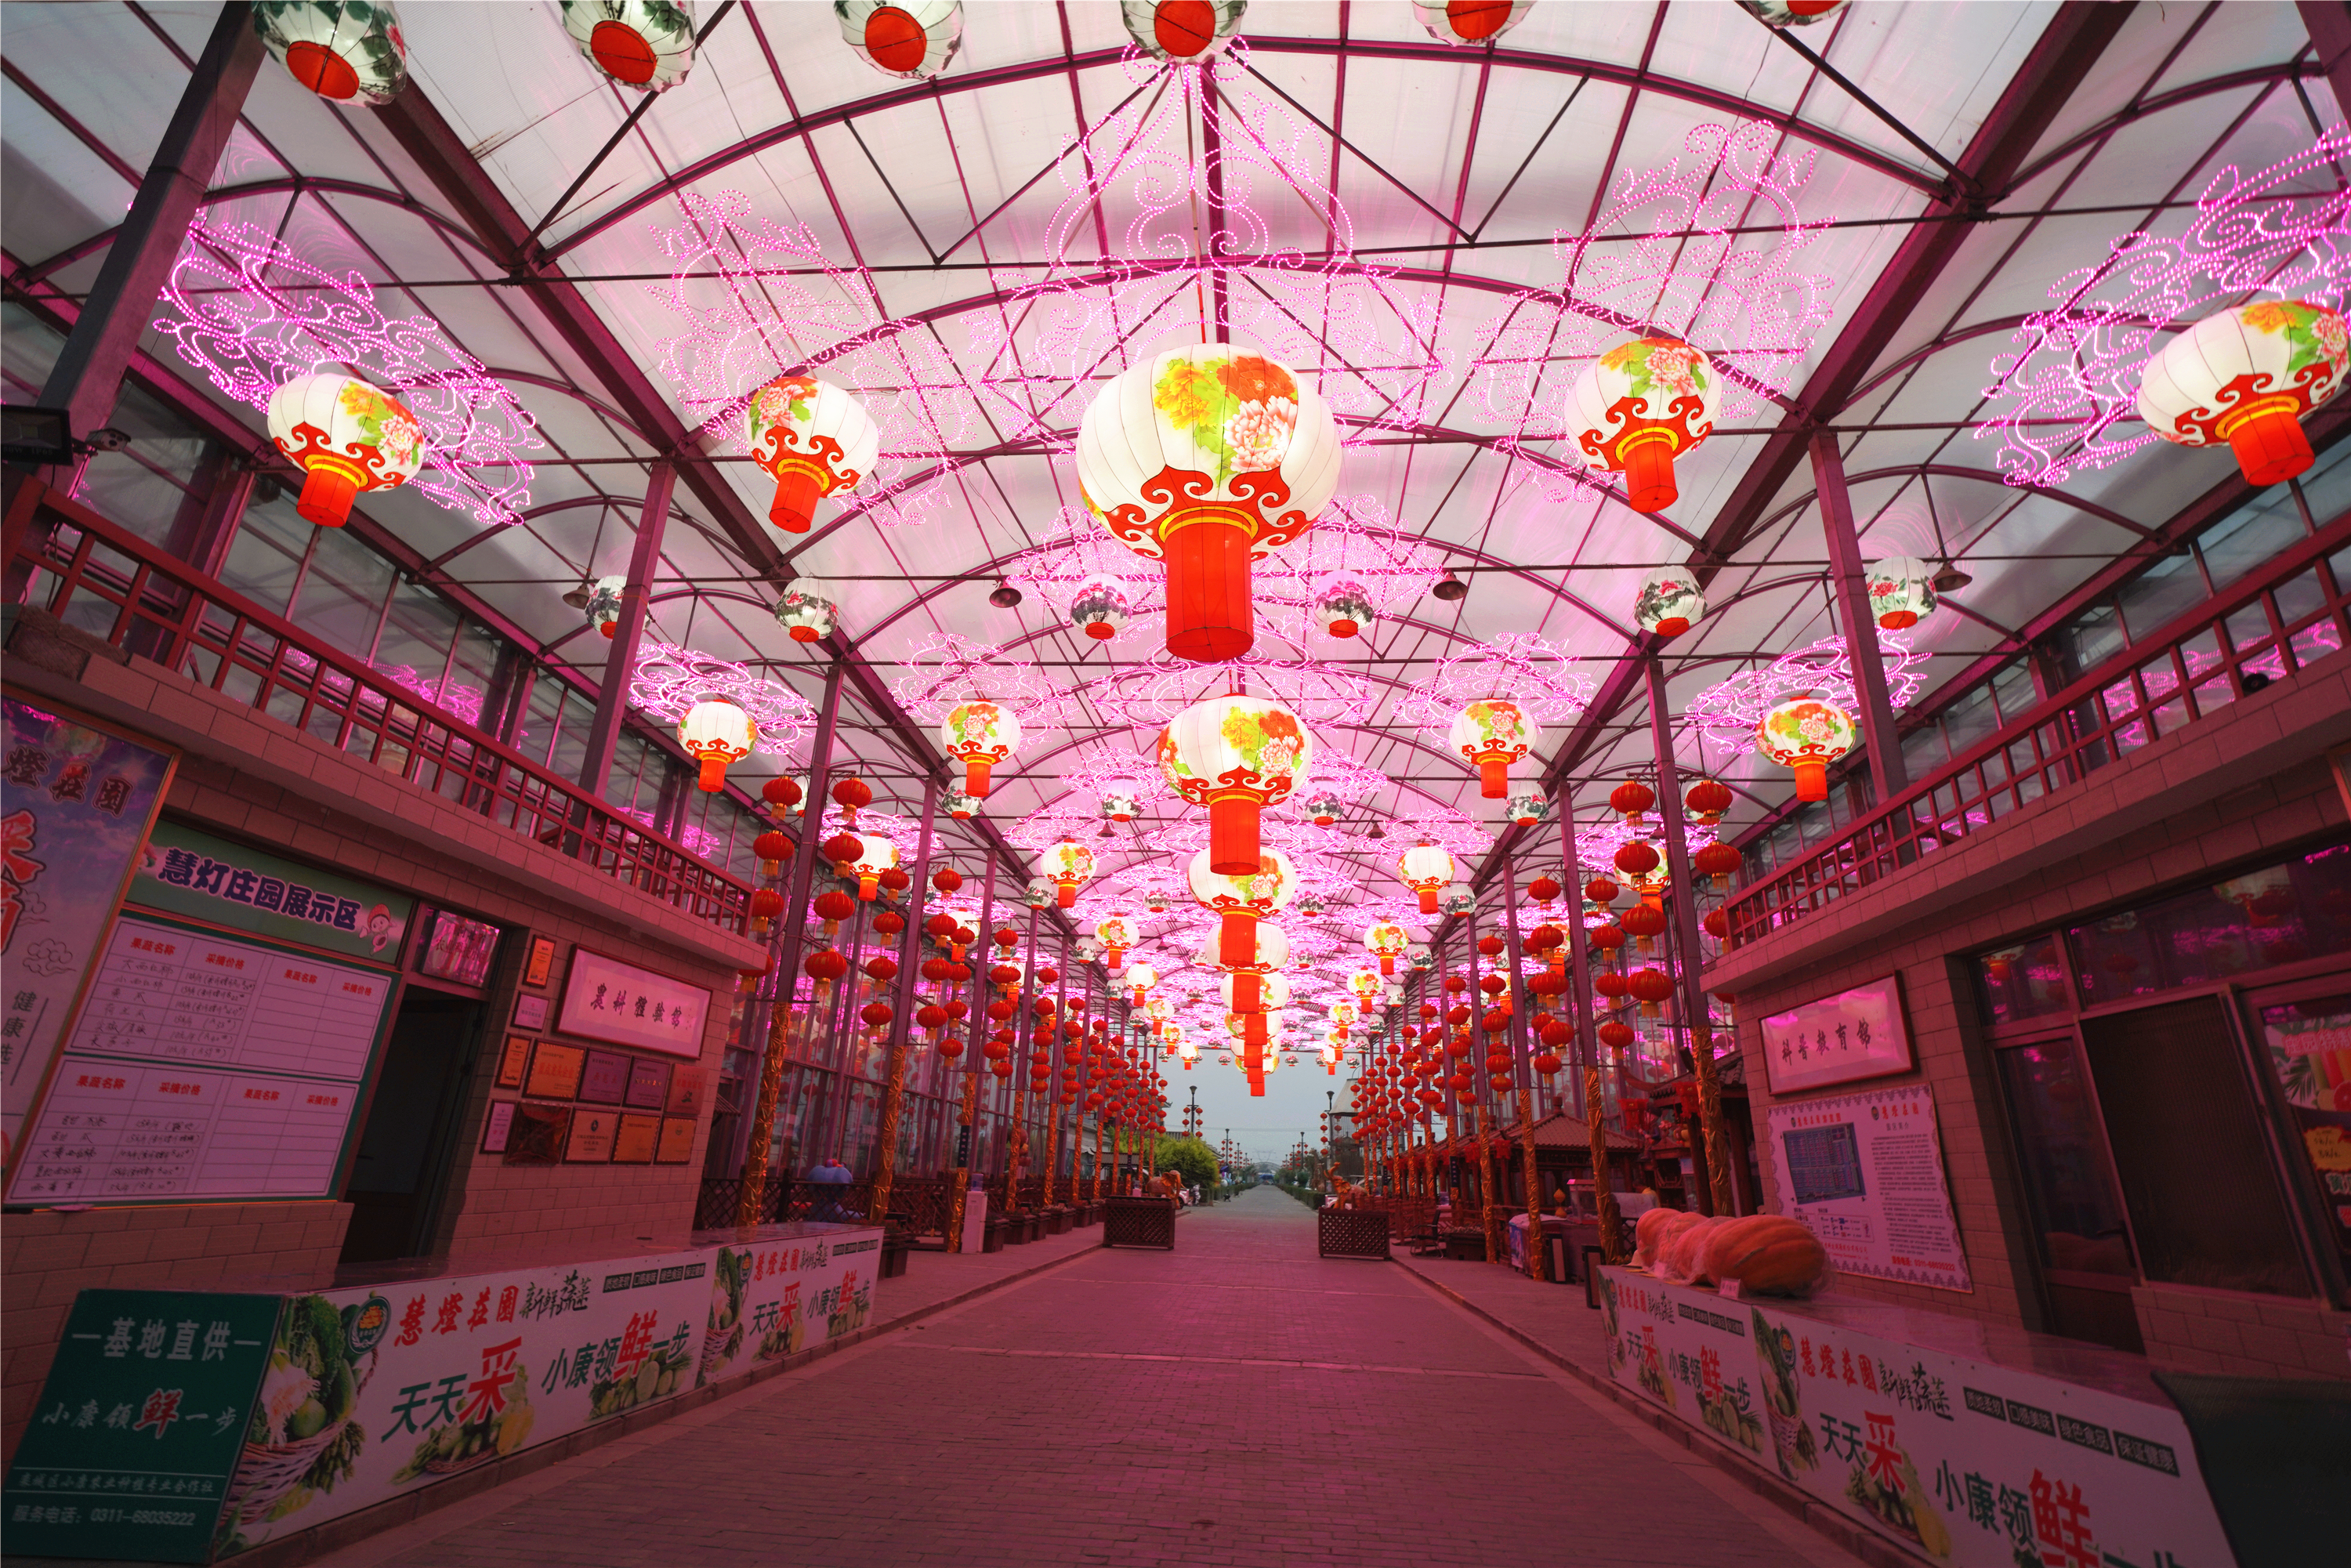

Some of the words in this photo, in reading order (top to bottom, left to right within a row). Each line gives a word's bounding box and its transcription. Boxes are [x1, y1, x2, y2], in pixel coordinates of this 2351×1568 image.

[158, 848, 361, 930] 慧灯庄园展示区
[130, 937, 176, 956] 果蔬名称
[205, 953, 245, 970] 采摘价格
[284, 969, 317, 984] 果蔬名称
[76, 1075, 125, 1091] 果蔬名称
[158, 1081, 201, 1096] 采摘价格
[244, 1087, 281, 1101] 果蔬名称
[749, 1280, 801, 1336] 天天采
[807, 1269, 870, 1319] 小康领鲜一步
[541, 1309, 690, 1395] 小康领鲜一步
[1626, 1325, 1660, 1371] 天天采
[1668, 1345, 1751, 1411] 小康领鲜一步
[381, 1336, 523, 1443] 天天采
[1819, 1410, 1906, 1494] 天天采
